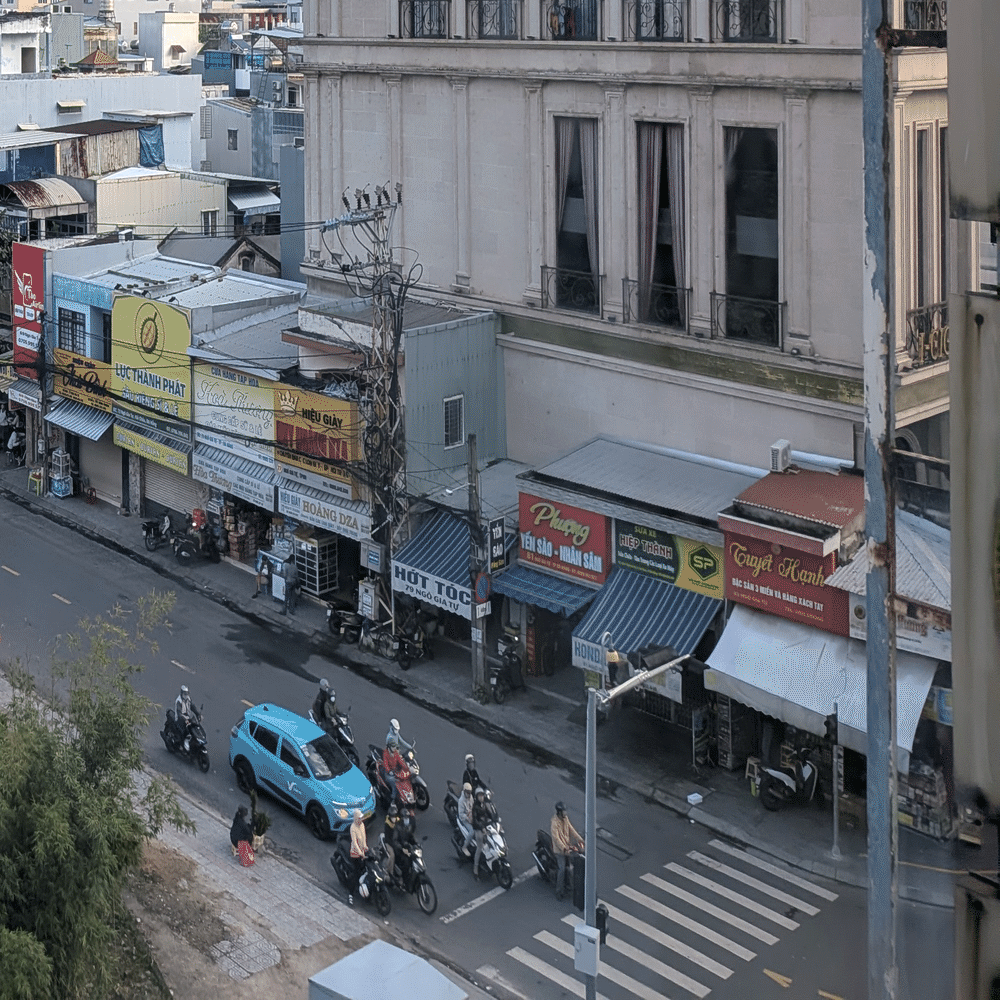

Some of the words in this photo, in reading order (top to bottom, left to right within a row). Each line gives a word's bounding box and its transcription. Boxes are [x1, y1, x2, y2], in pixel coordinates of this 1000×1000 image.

[115, 362, 131, 381] LỤC
[133, 367, 161, 391] THÀNH
[162, 378, 186, 398] PHÁT
[135, 390, 155, 409] RIÊNG
[301, 406, 321, 424] HIỆU
[322, 414, 343, 429] GIÀY
[291, 494, 301, 508] GIÀY
[302, 498, 338, 522] HOÀNG
[338, 511, 360, 531] DZA
[529, 502, 590, 546] Phượng
[491, 522, 503, 540] YẾN
[648, 529, 657, 538] XE
[492, 542, 504, 558] SÀO
[520, 530, 536, 553] YẾN
[536, 536, 553, 558] SÀO
[559, 545, 582, 567] NHÂN
[583, 551, 603, 574] SÂM
[526, 551, 534, 561] 81
[618, 533, 640, 551] HIỆP
[640, 540, 673, 560] THÀNH
[693, 555, 715, 570] SP
[729, 541, 774, 578] Tuyết
[777, 556, 825, 588] Hạnh
[394, 564, 430, 590] HỚT
[434, 580, 472, 606] TÓC
[405, 584, 414, 593] 79
[415, 588, 433, 600] NGÔ
[433, 594, 448, 607] GIA
[448, 601, 460, 612] TỰ
[731, 577, 743, 590] ĐẶC
[743, 579, 755, 592] SẢN
[755, 584, 759, 592] 3
[759, 585, 774, 598] MIỀN
[774, 588, 782, 599] VÀ
[782, 591, 798, 604] HÀNG
[798, 596, 814, 609] XÁCH
[814, 601, 824, 612] TAY
[573, 640, 606, 666] HOND
